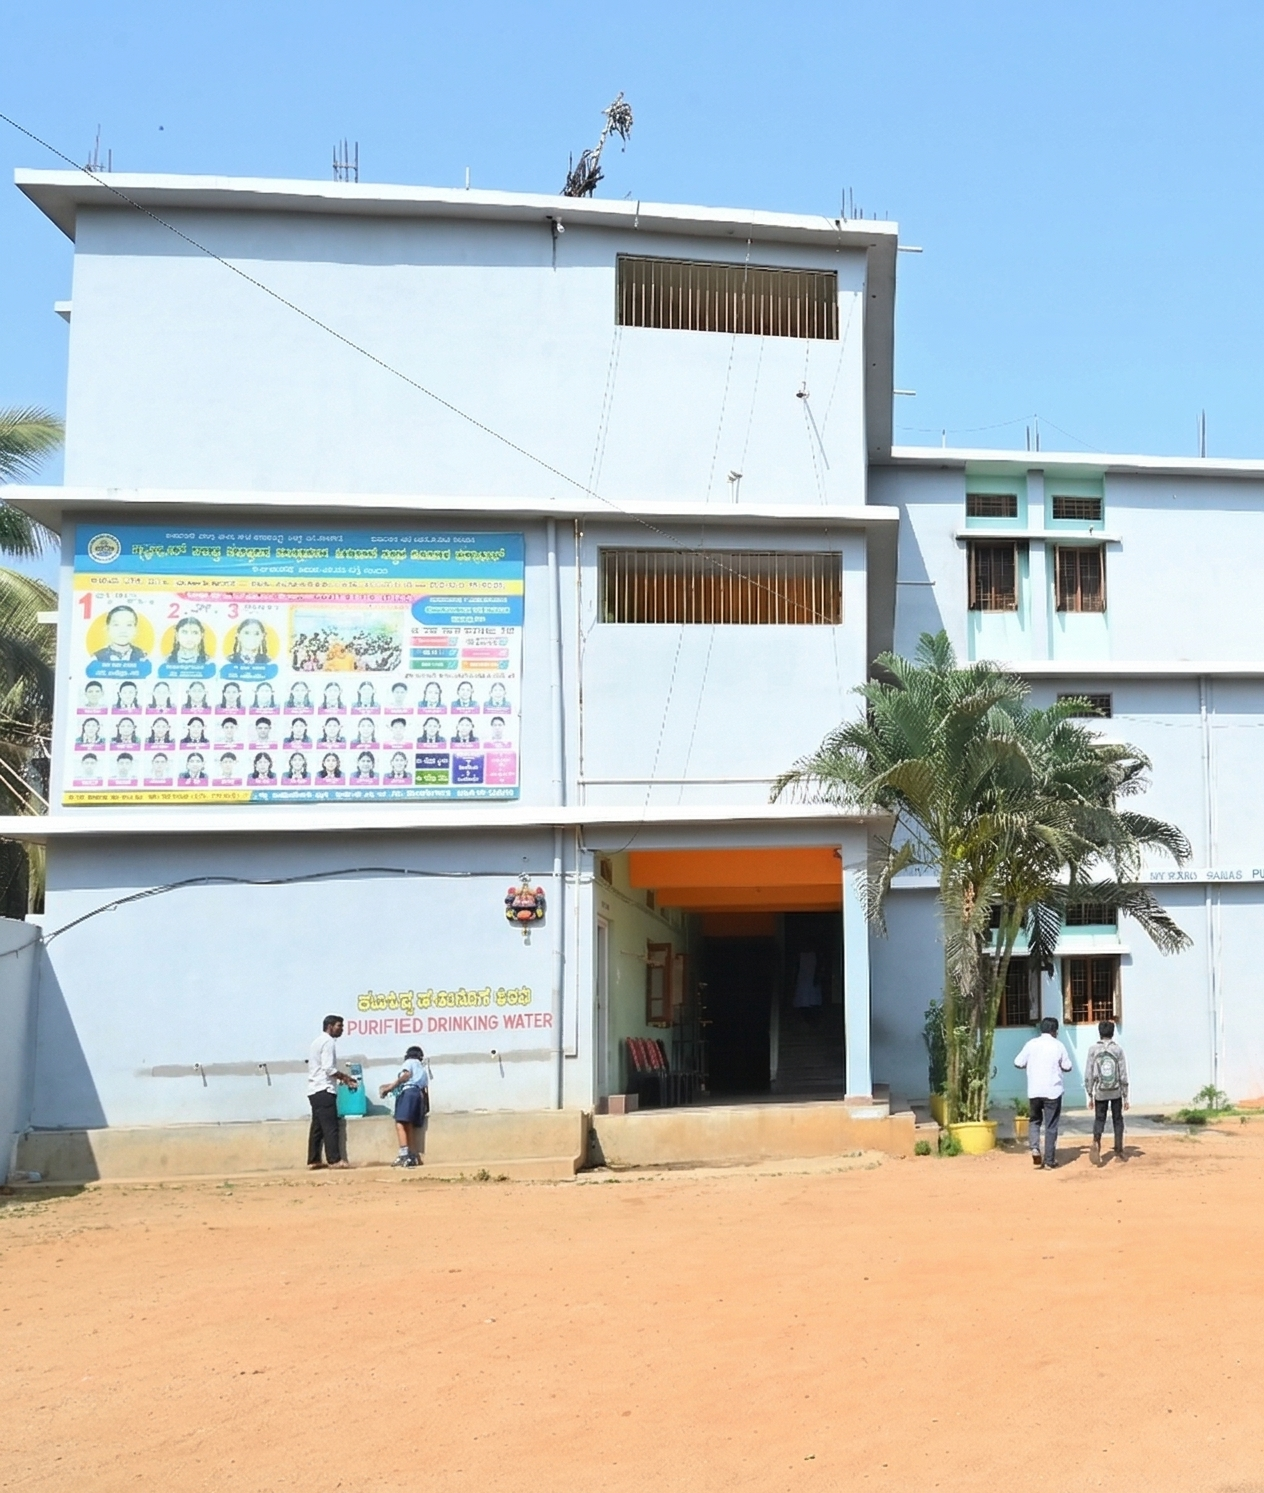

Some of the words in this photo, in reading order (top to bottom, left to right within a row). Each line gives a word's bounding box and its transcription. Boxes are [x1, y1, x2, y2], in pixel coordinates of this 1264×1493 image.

[78, 592, 93, 619] 1
[167, 602, 180, 619] 2
[227, 603, 239, 619] 3
[347, 1017, 424, 1036] PURIFIED
[427, 1015, 499, 1033] DRINKING
[503, 1012, 553, 1030] WATER
